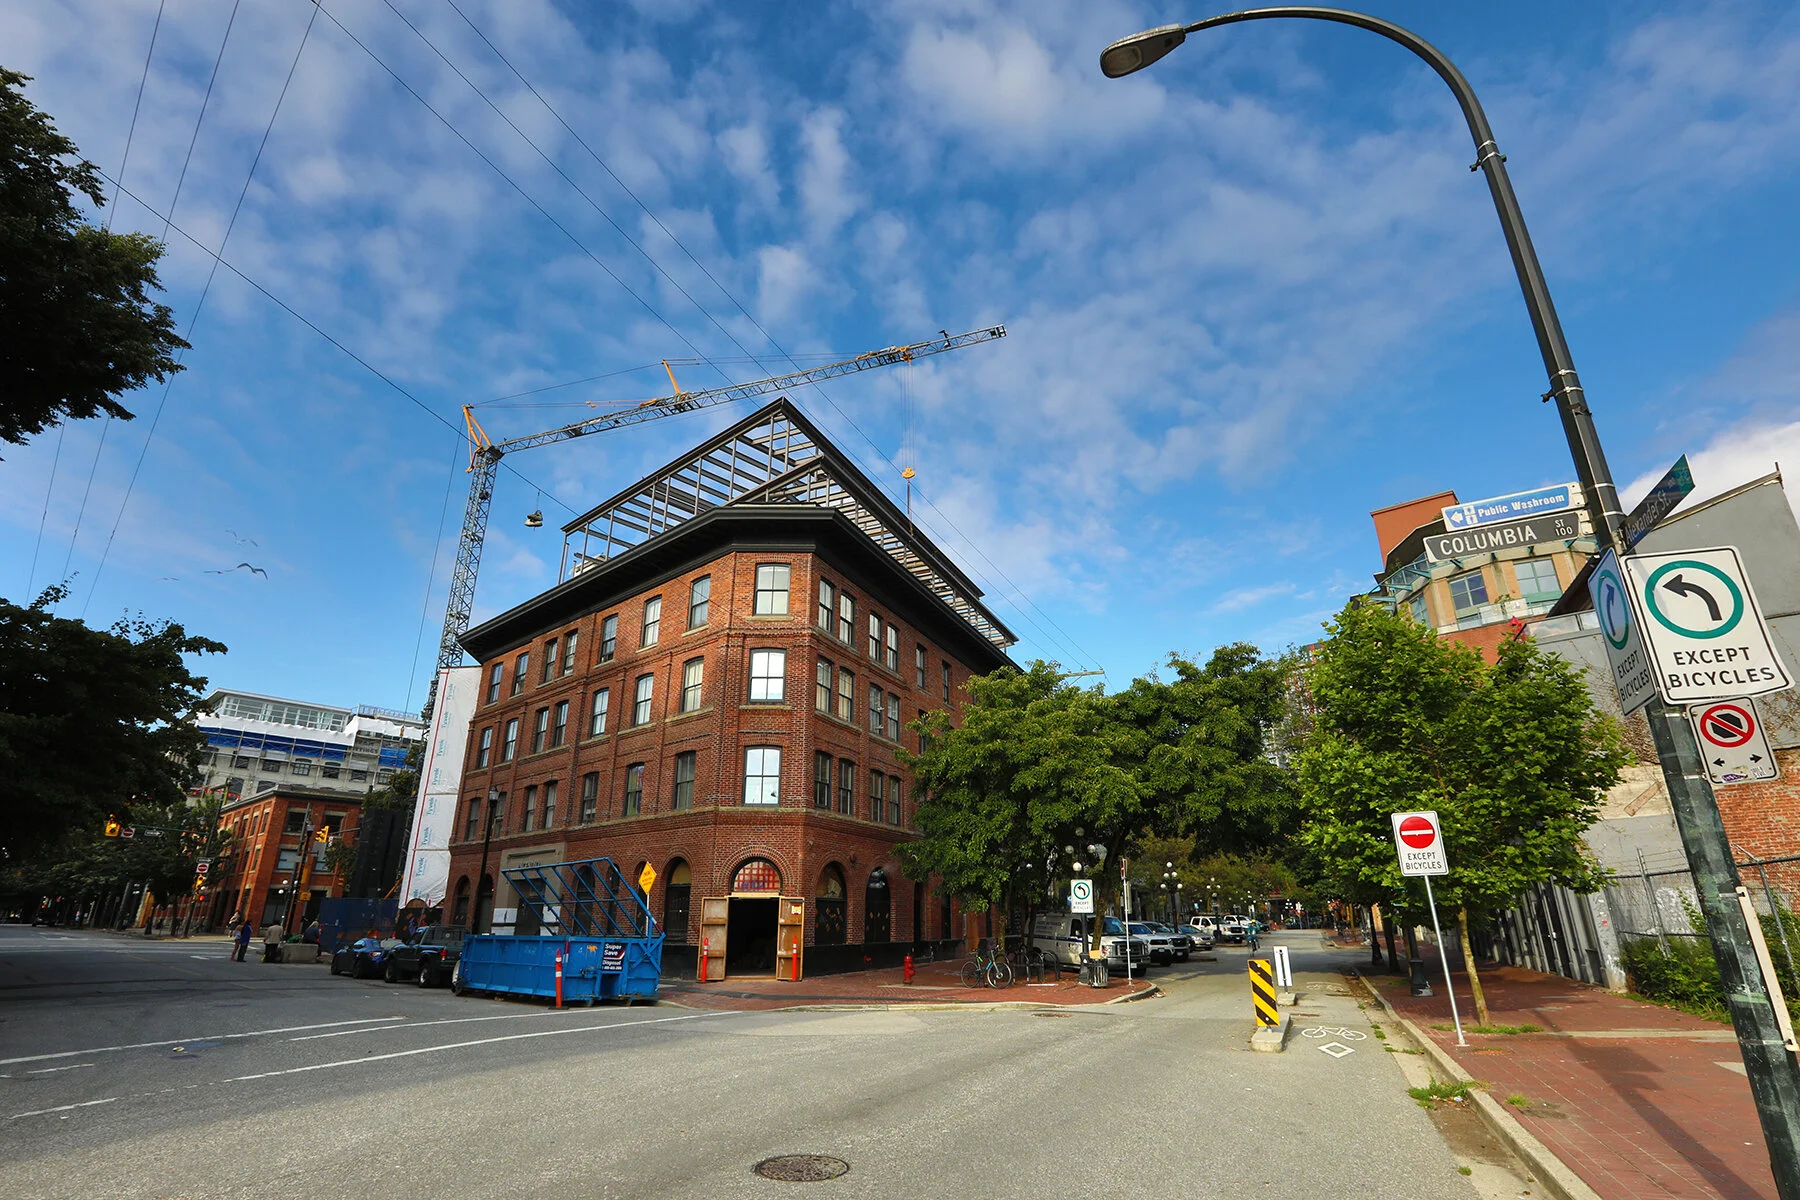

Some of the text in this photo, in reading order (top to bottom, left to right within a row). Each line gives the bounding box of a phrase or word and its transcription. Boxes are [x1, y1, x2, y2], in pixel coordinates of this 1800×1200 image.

[1478, 494, 1565, 518] Public Washroom
[1555, 519, 1565, 527] ST
[1555, 526, 1573, 536] 100
[1624, 501, 1661, 545] Alexander
[1440, 525, 1537, 556] COLUMBIA
[1617, 650, 1640, 679] EXCEPT
[1673, 646, 1750, 666] EXCEPT
[1620, 668, 1650, 702] BICYCLES
[1667, 667, 1775, 688] BICYCLES
[431, 767, 439, 785] Tyvek
[426, 797, 434, 815] Tyvek
[421, 827, 429, 845] Tyvek
[1405, 861, 1442, 870] BICYCLES
[1407, 852, 1436, 860] EXCEPT
[415, 857, 424, 876] Tyvek
